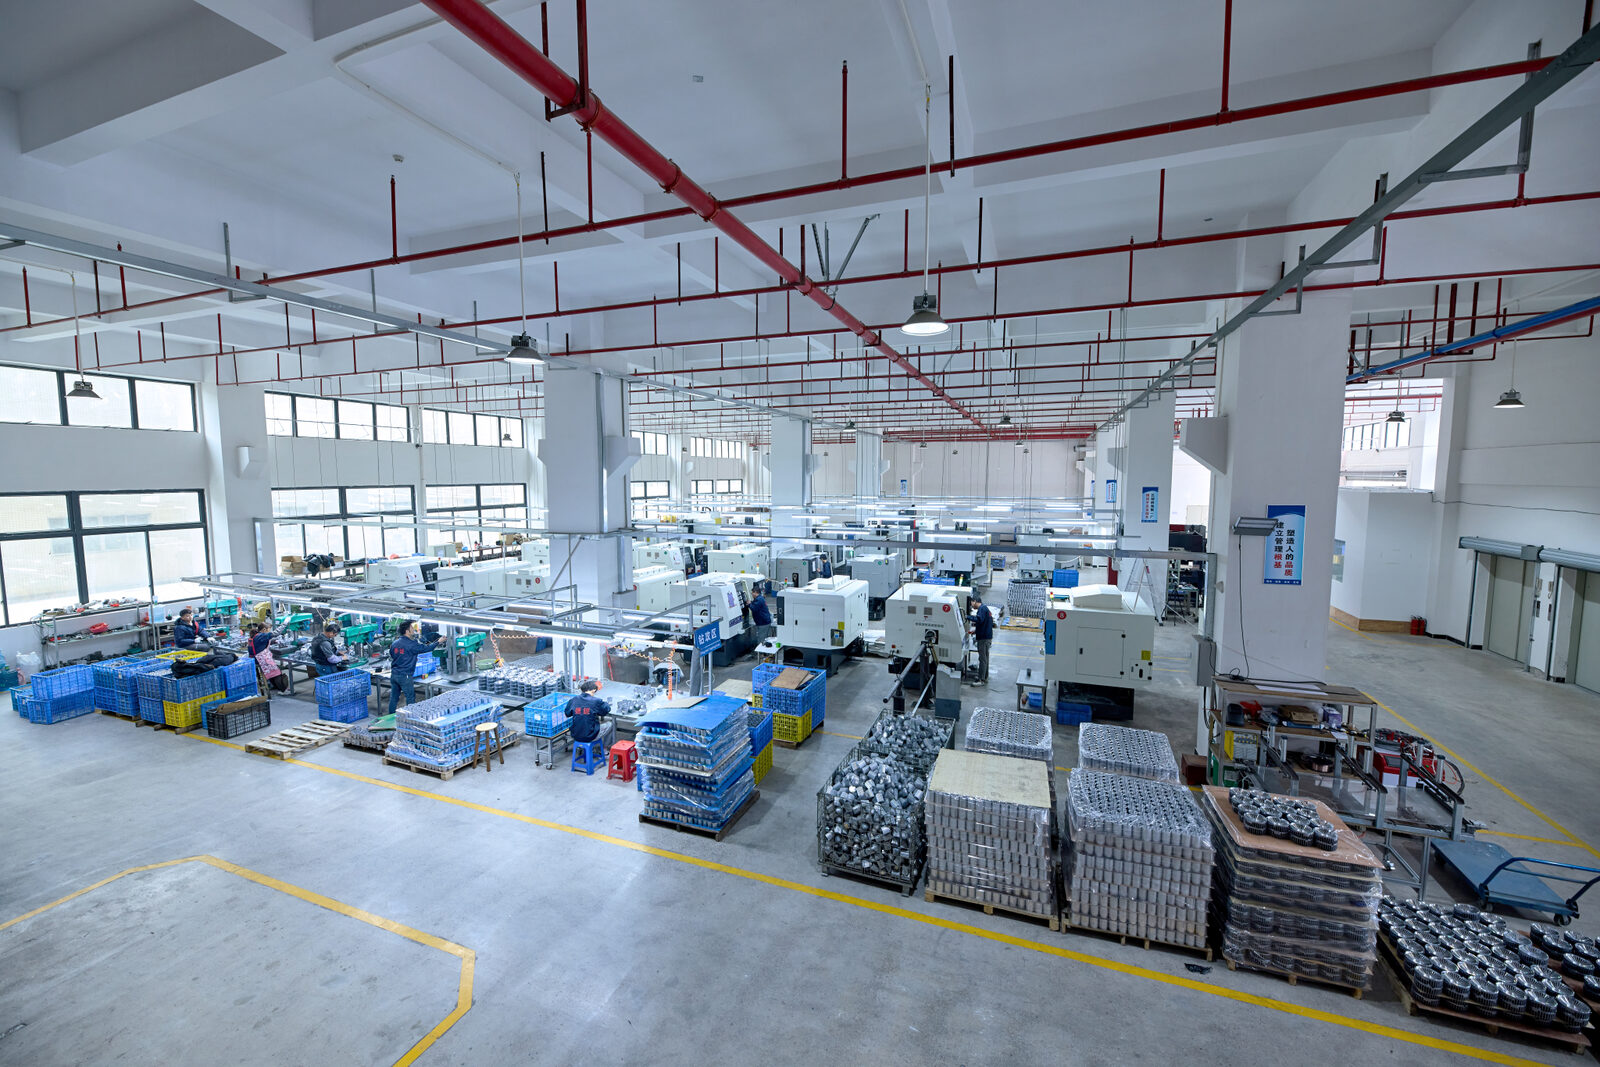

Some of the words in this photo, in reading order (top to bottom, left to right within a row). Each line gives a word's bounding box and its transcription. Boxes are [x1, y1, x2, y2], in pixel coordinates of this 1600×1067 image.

[1273, 521, 1285, 569] 建立管理根基
[1284, 529, 1295, 576] 塑造人的品质
